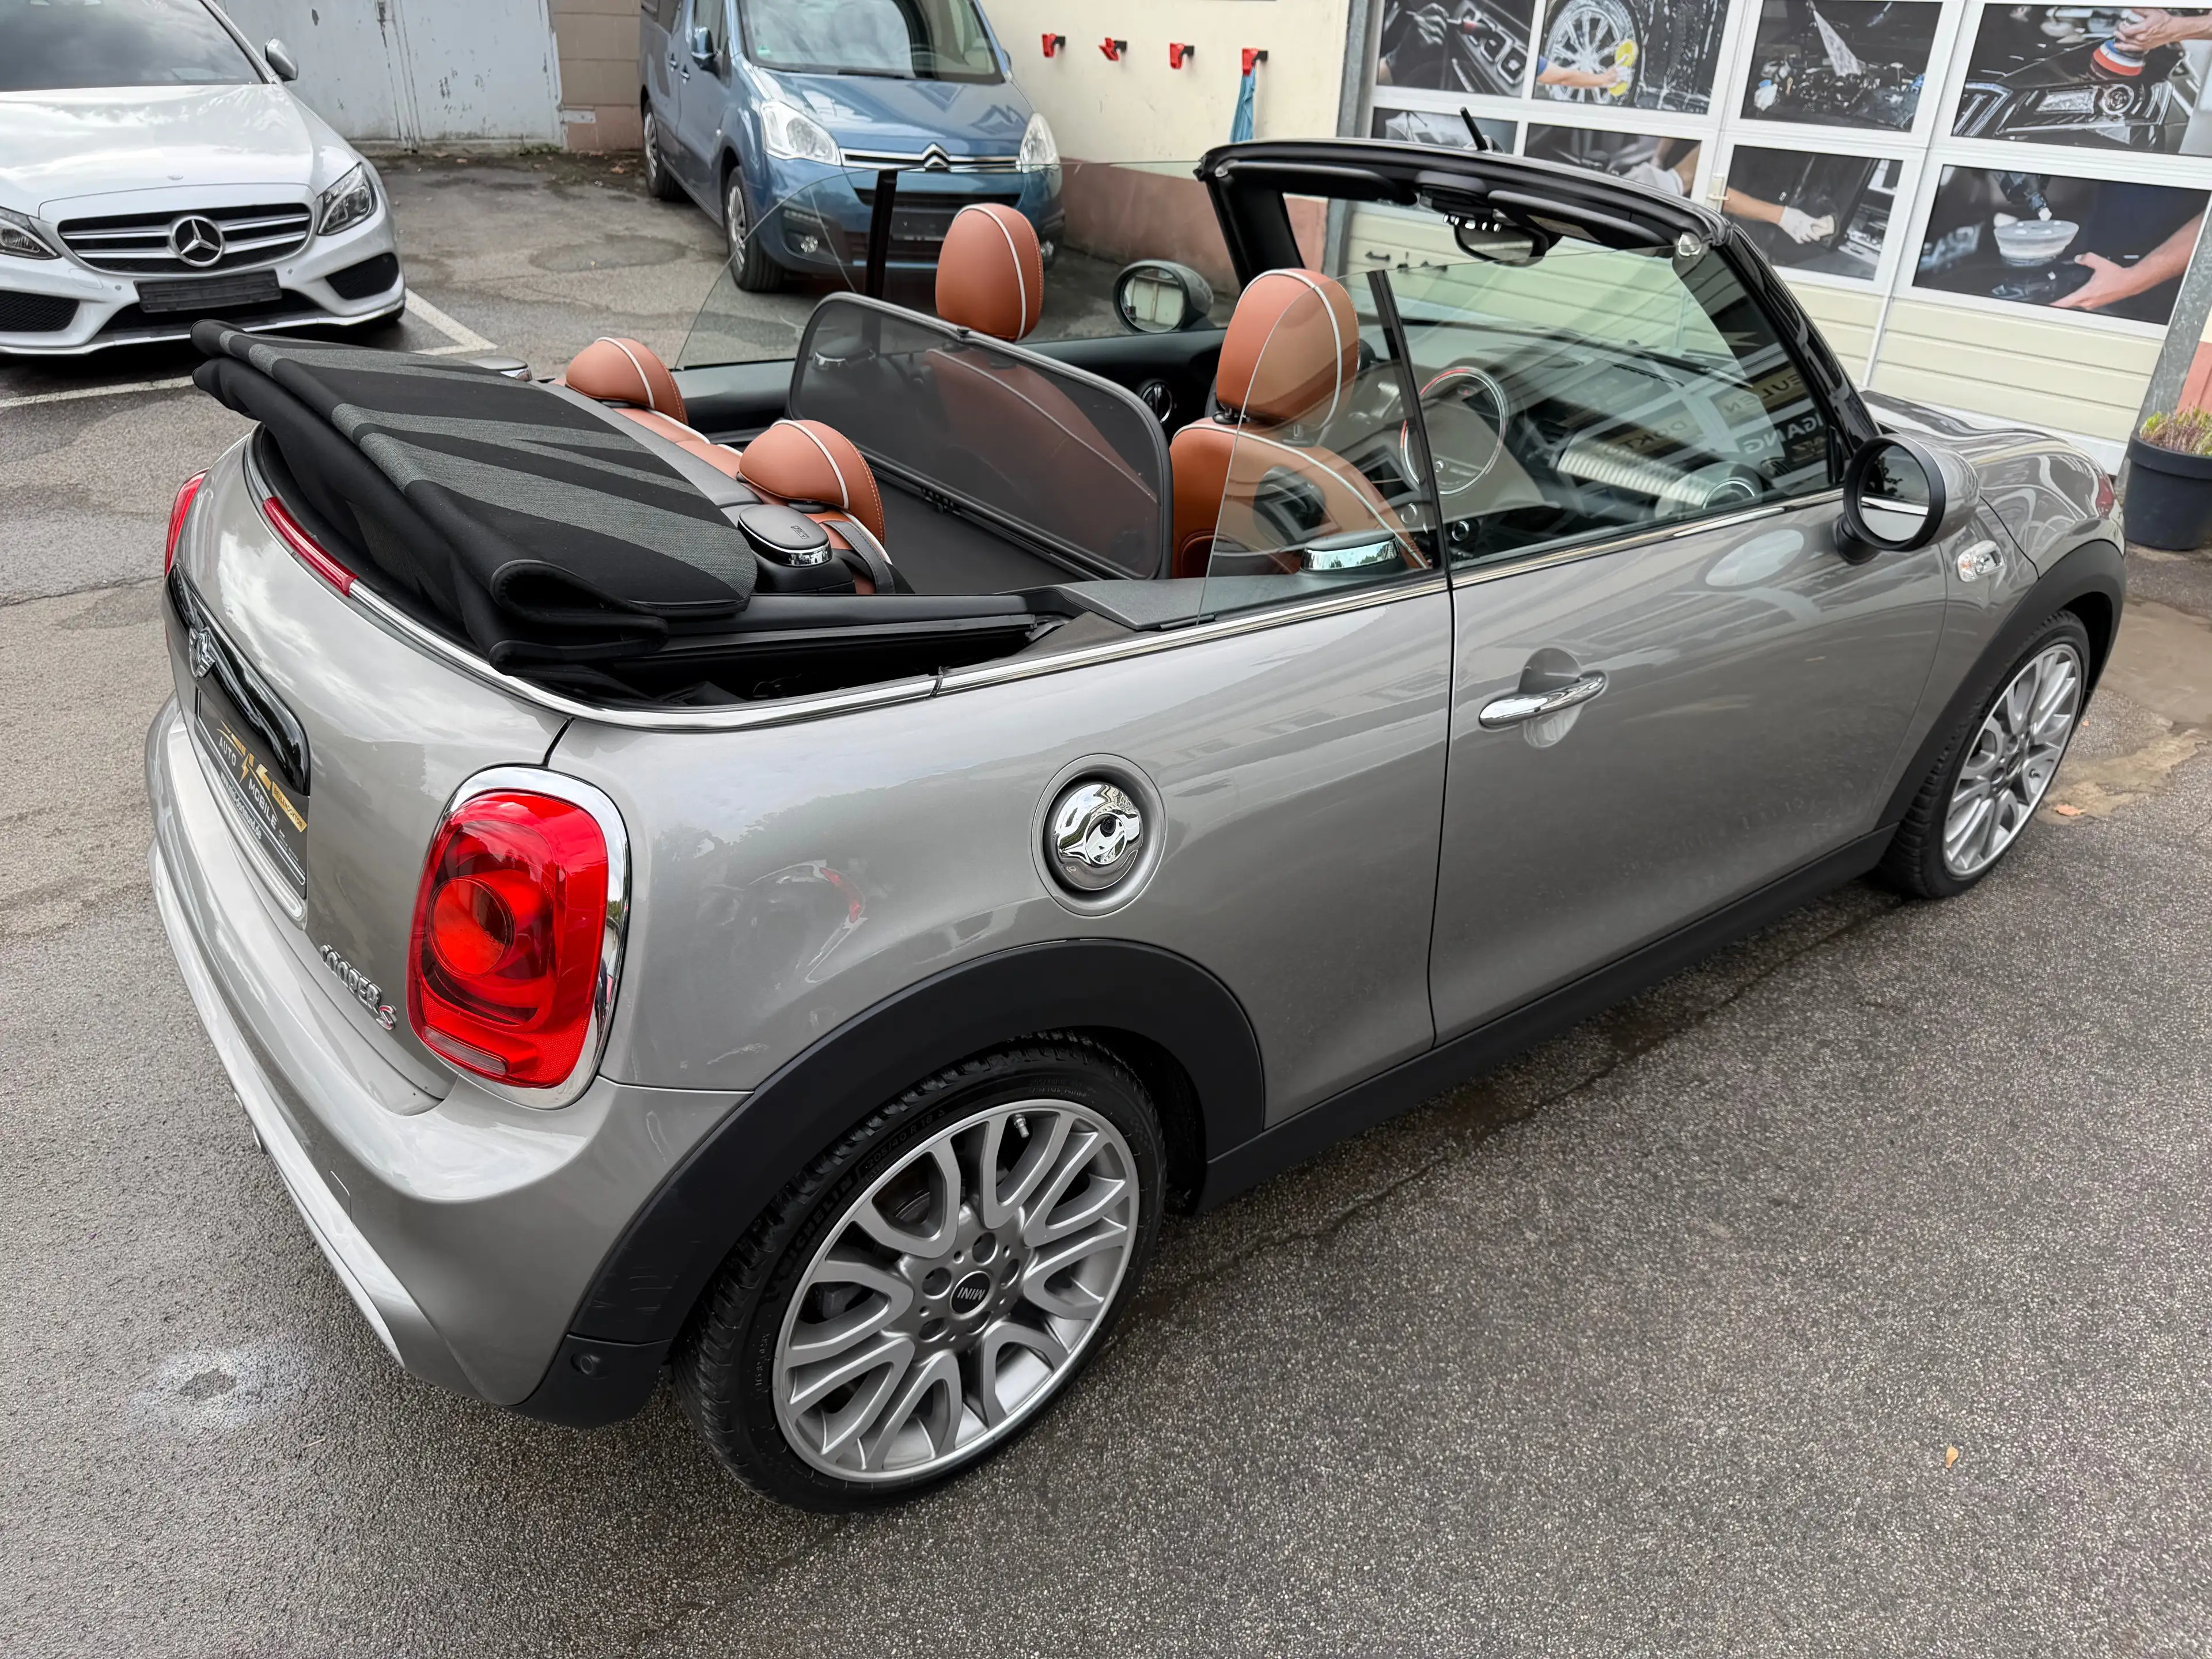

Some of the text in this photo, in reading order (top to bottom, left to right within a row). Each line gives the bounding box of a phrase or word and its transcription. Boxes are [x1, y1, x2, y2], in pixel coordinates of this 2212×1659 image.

[218, 737, 277, 830] AUTO MOBILE
[274, 787, 302, 828] BEULENDOKTOR
[320, 945, 397, 1029] COOPER S
[868, 1115, 933, 1166] 205/40 R 18
[778, 1179, 854, 1277] MICHELIN
[957, 1287, 986, 1300] MINI
